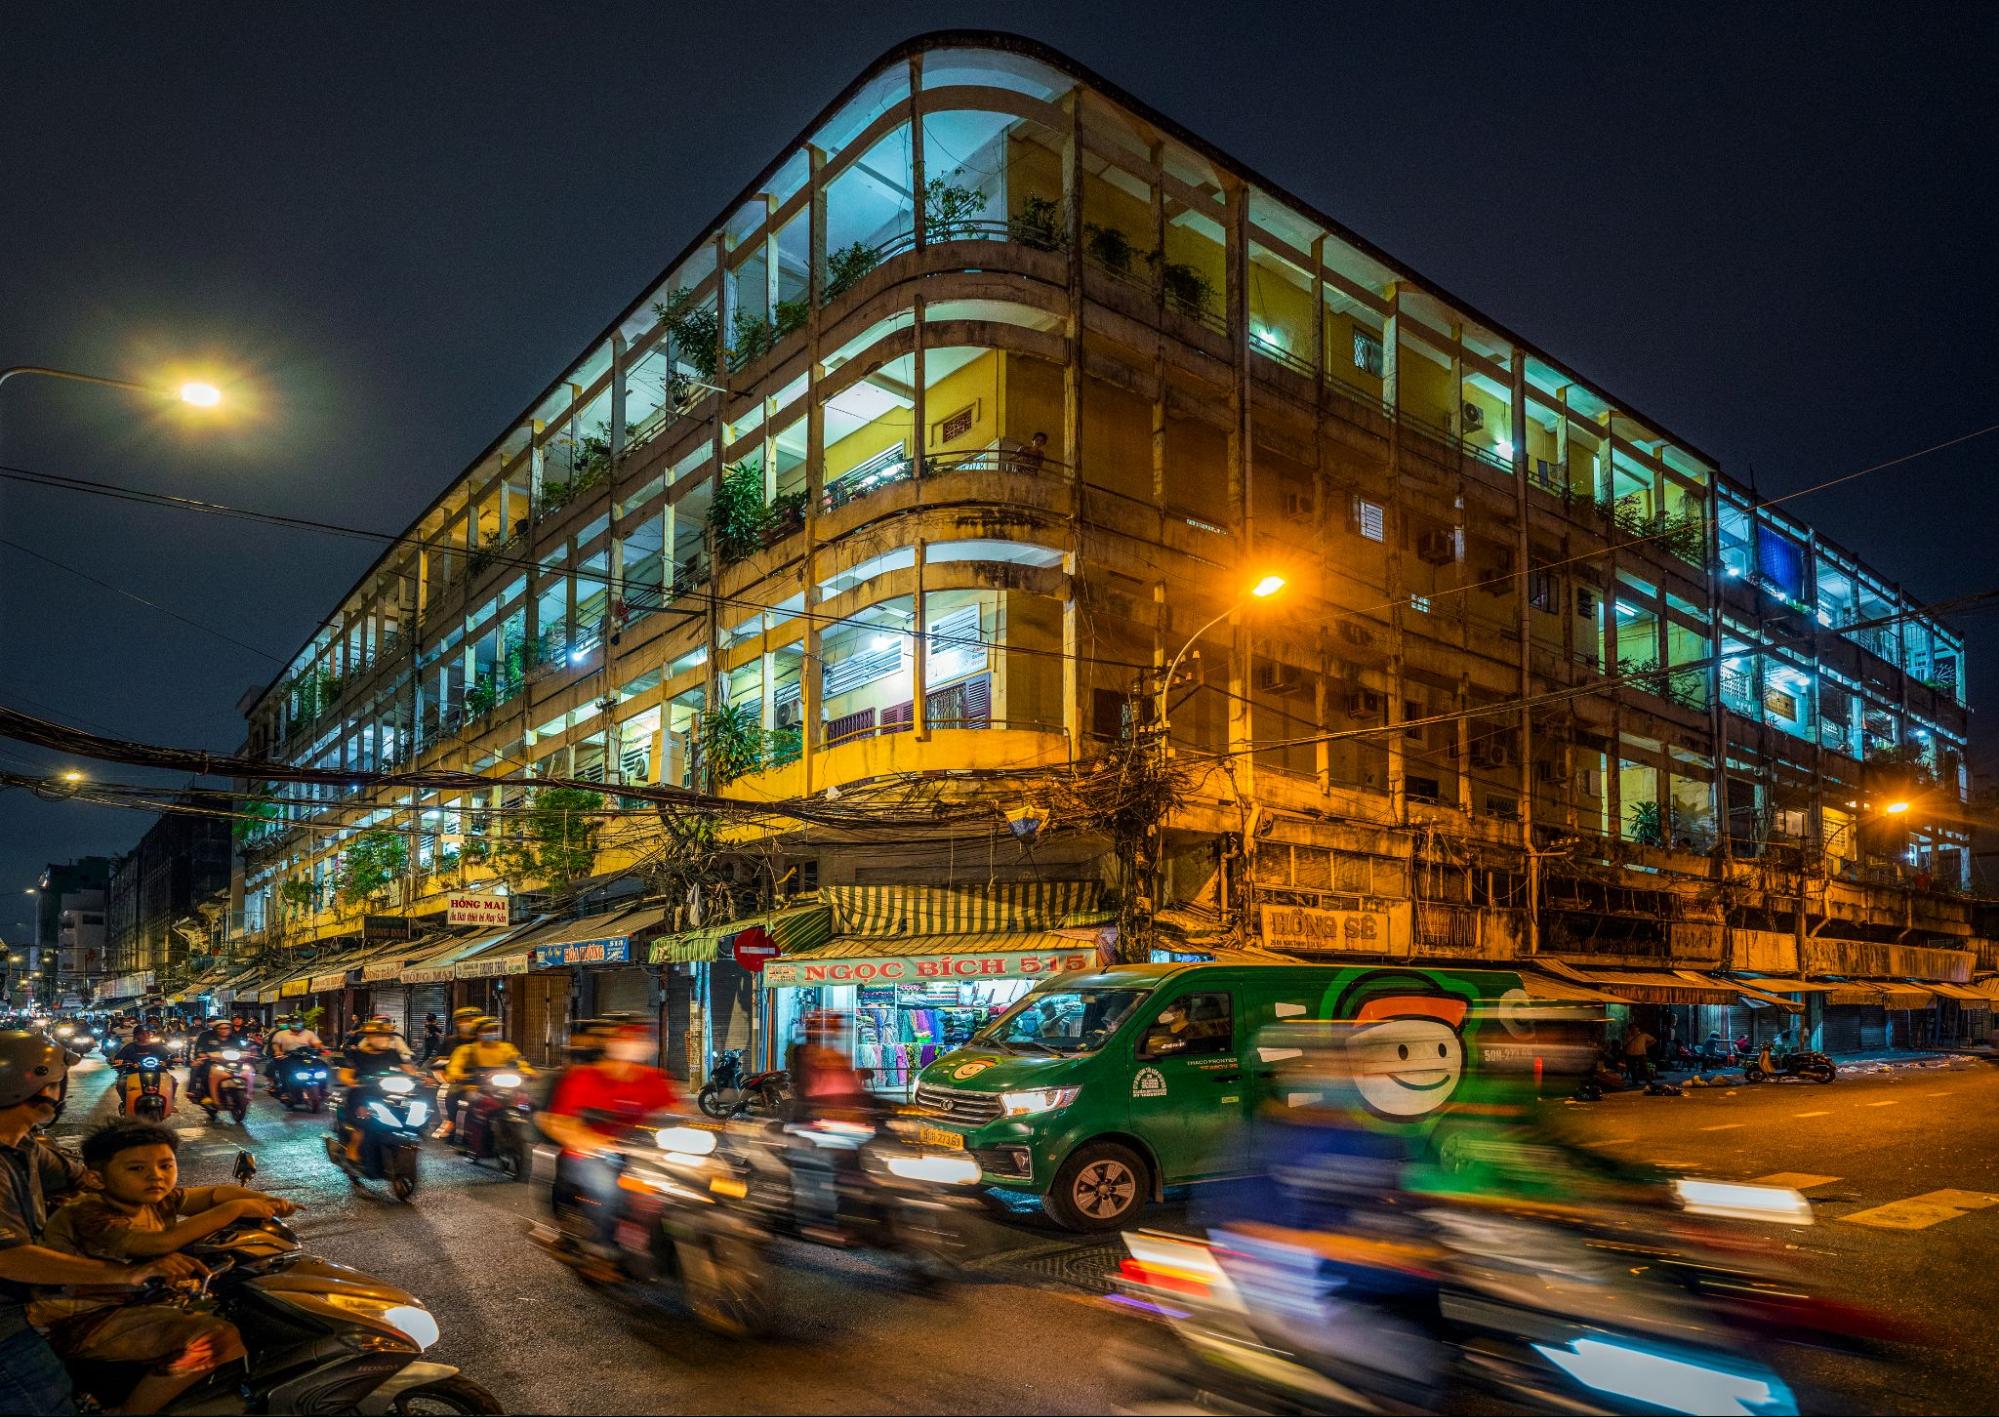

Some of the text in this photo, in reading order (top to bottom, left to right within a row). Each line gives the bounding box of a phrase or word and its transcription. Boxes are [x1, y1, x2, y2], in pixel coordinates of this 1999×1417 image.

[484, 901, 506, 910] MAI
[804, 961, 904, 983] NGỌC
[915, 956, 1008, 978] BÍCH
[1019, 953, 1088, 974] 515
